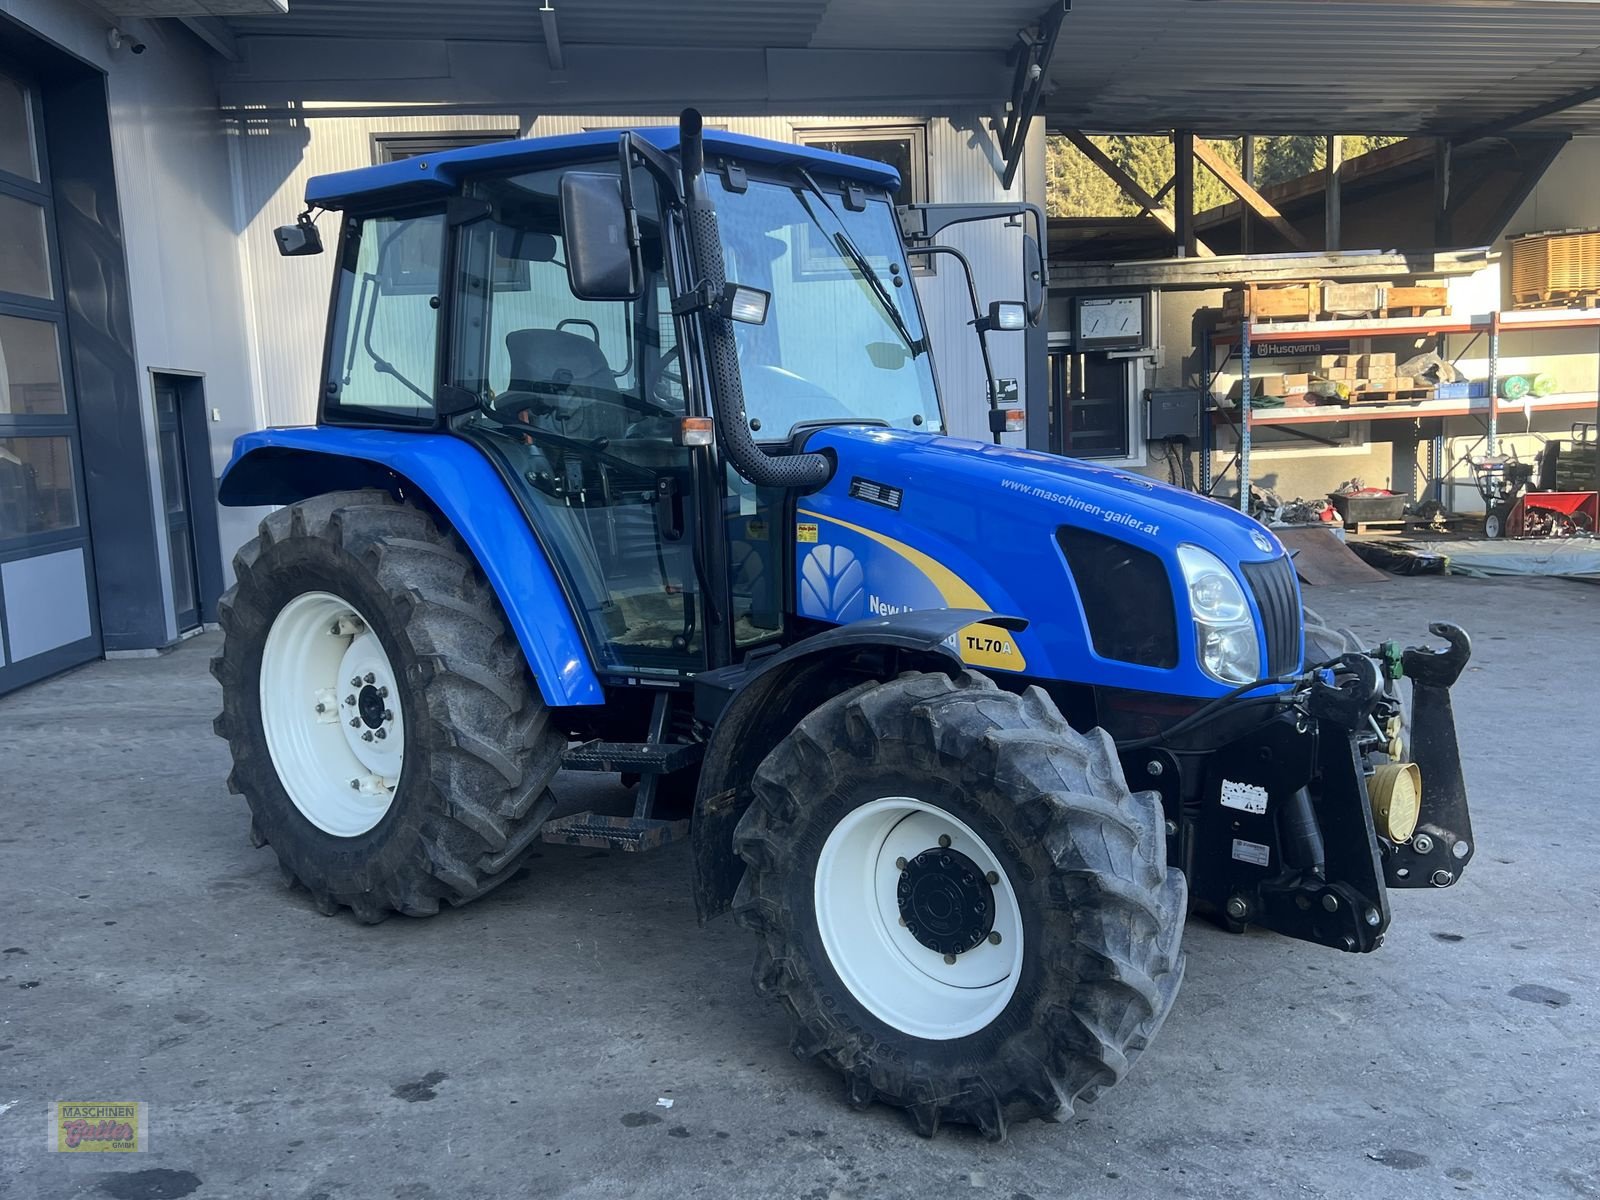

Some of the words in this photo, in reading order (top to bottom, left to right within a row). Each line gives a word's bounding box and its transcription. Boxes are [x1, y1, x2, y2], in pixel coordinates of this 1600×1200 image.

[1268, 344, 1321, 355] Husqvarna
[1001, 477, 1159, 536] www.maschinen-gailer.at
[869, 594, 899, 616] New
[966, 636, 1012, 655] TL70A
